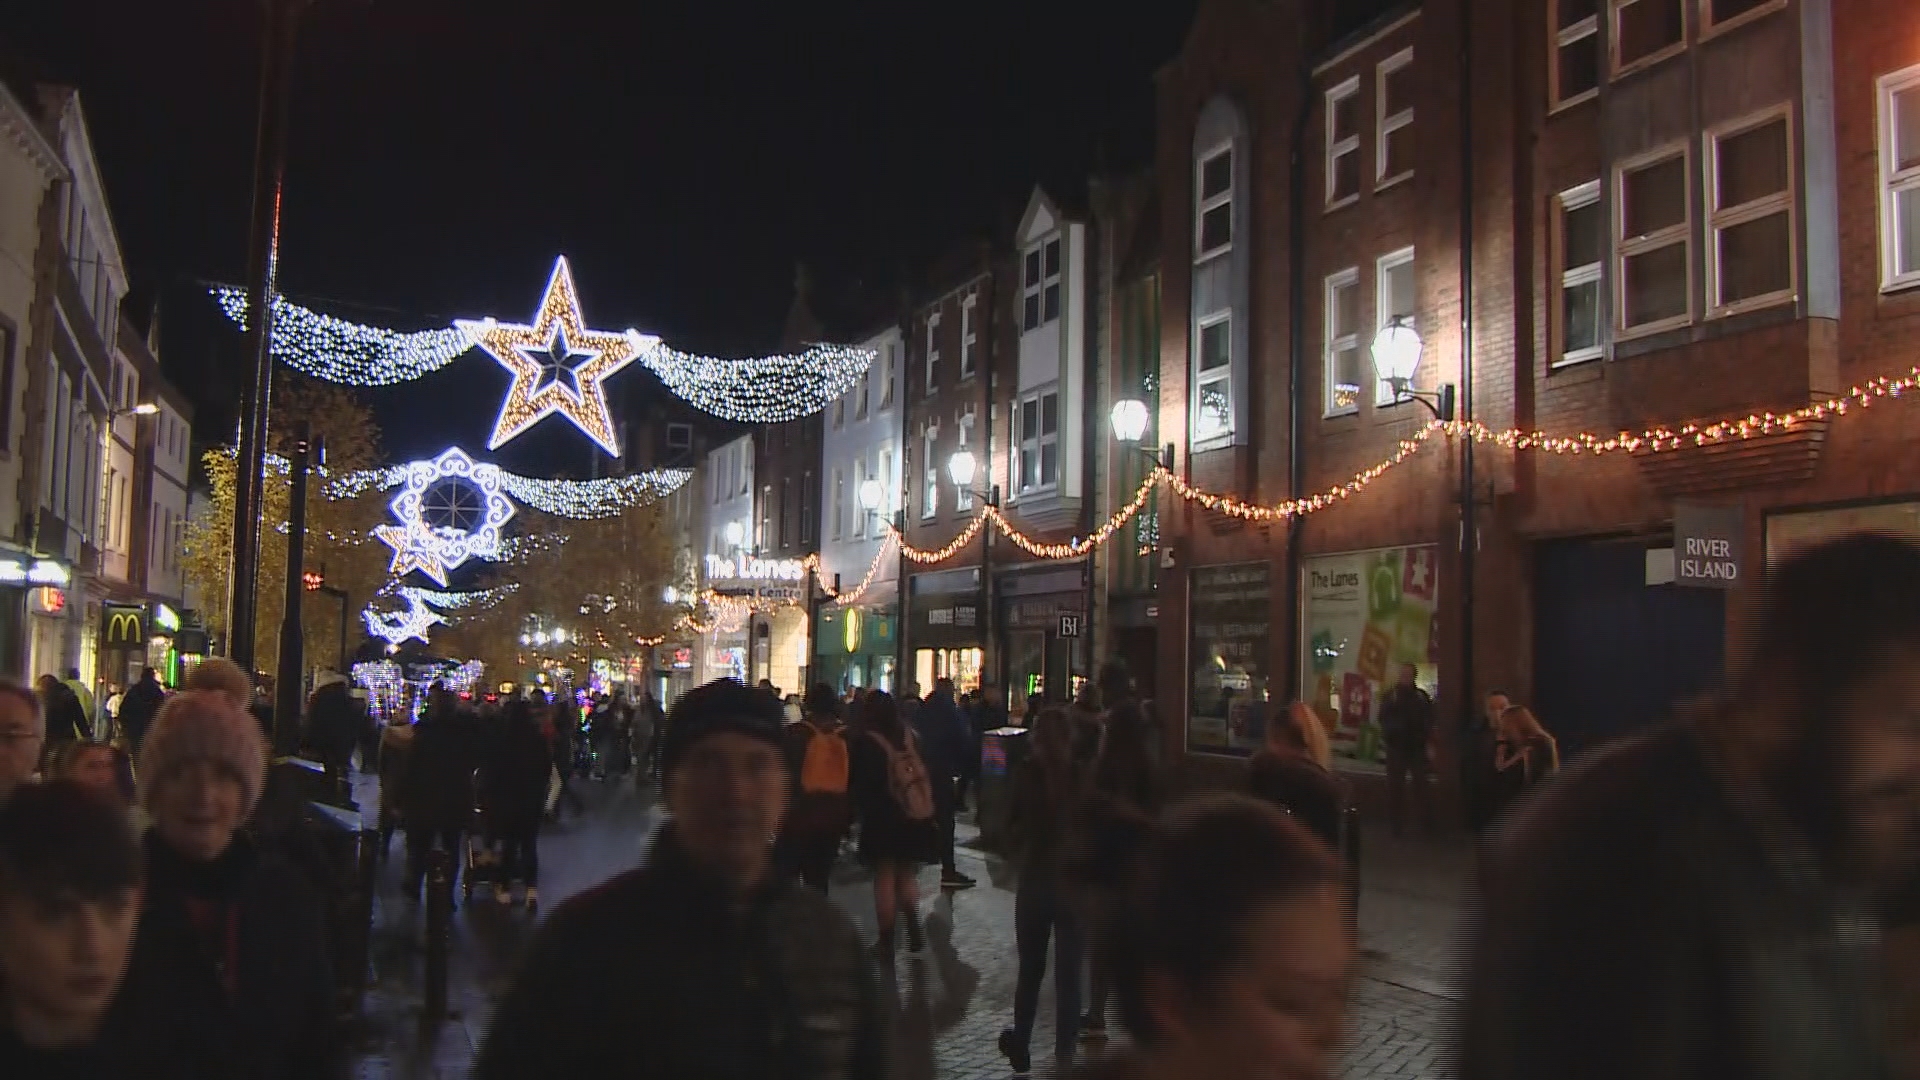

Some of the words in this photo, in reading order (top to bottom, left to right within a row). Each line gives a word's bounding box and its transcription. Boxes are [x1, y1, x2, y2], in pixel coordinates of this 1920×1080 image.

[1686, 538, 1730, 557] RIVER
[705, 554, 735, 579] The
[738, 554, 804, 580] Lanes
[1680, 559, 1737, 580] ISLAND
[1311, 571, 1328, 588] The
[1330, 569, 1359, 586] Lanes
[759, 586, 801, 598] Centre
